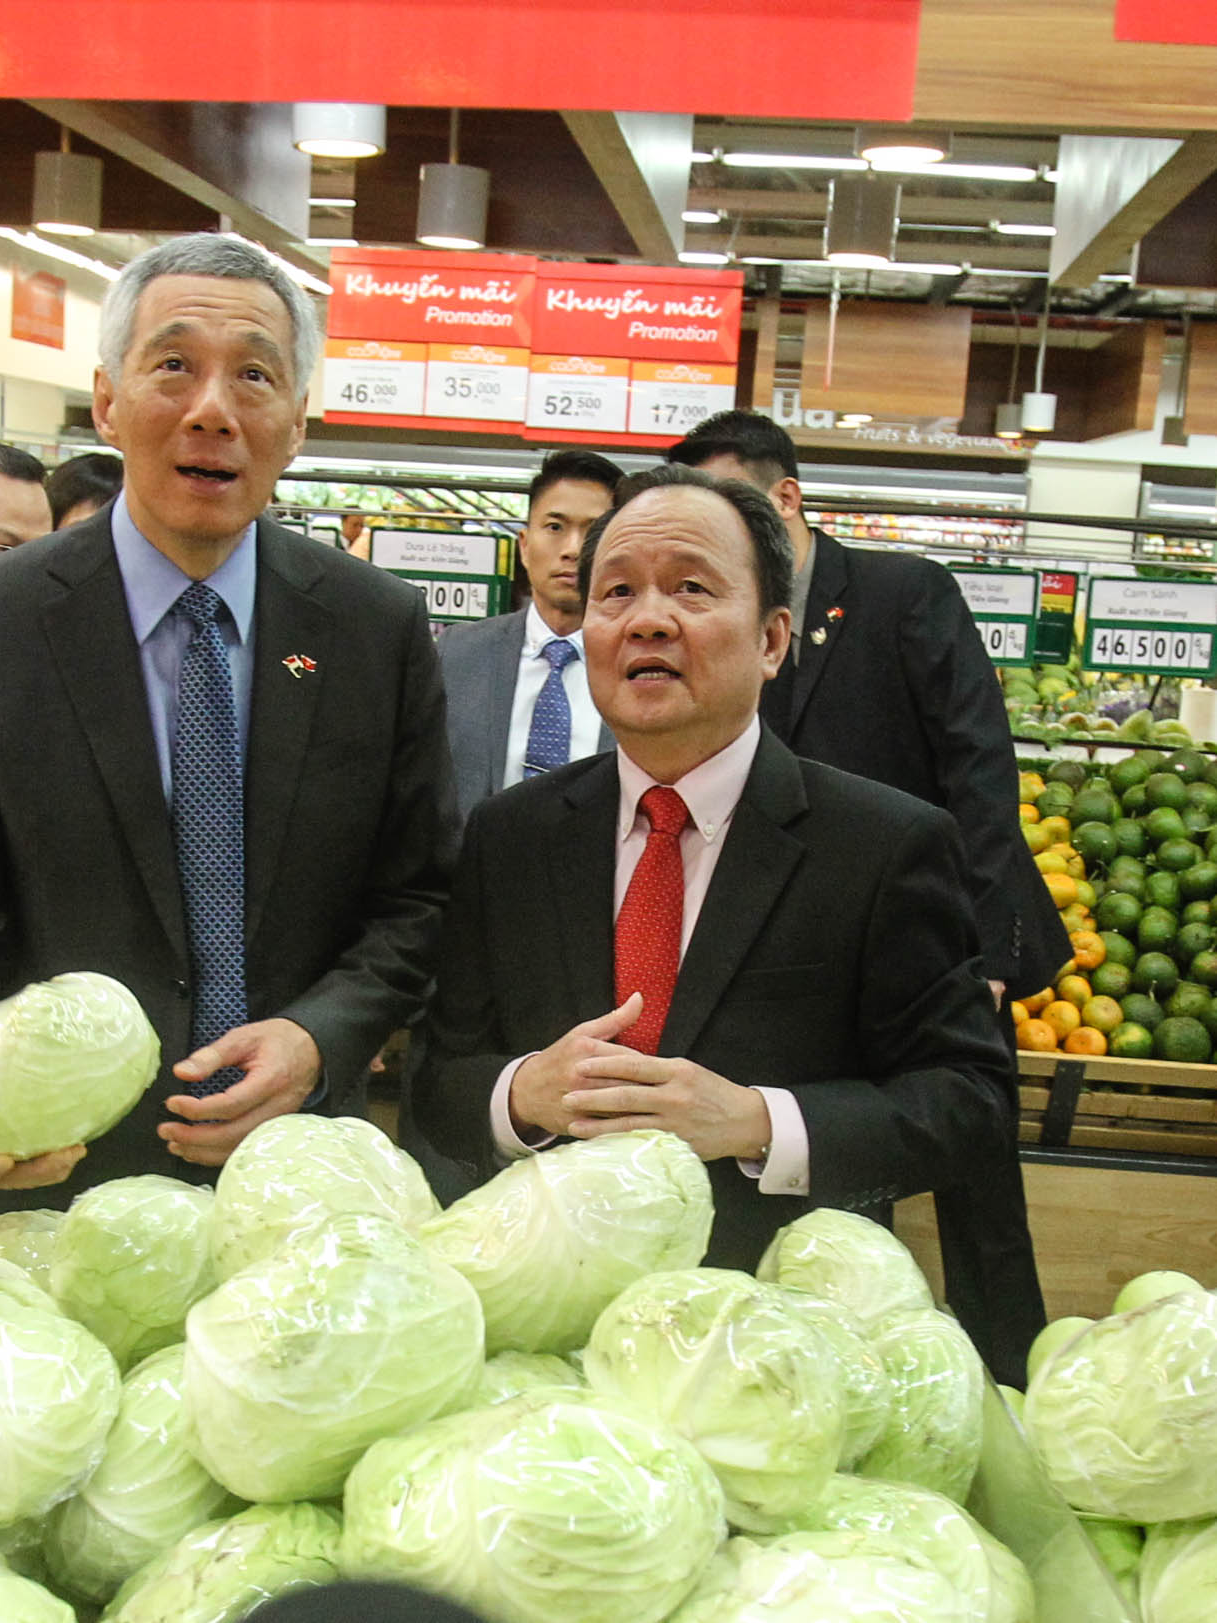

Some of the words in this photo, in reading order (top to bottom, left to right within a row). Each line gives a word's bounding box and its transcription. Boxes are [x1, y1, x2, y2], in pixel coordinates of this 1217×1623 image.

[345, 273, 455, 304] Khuyến
[459, 280, 518, 304] mãi
[425, 305, 513, 327] Promotion
[546, 288, 659, 320] Khuyến
[663, 295, 723, 319] mãi
[627, 321, 718, 343] Promotion
